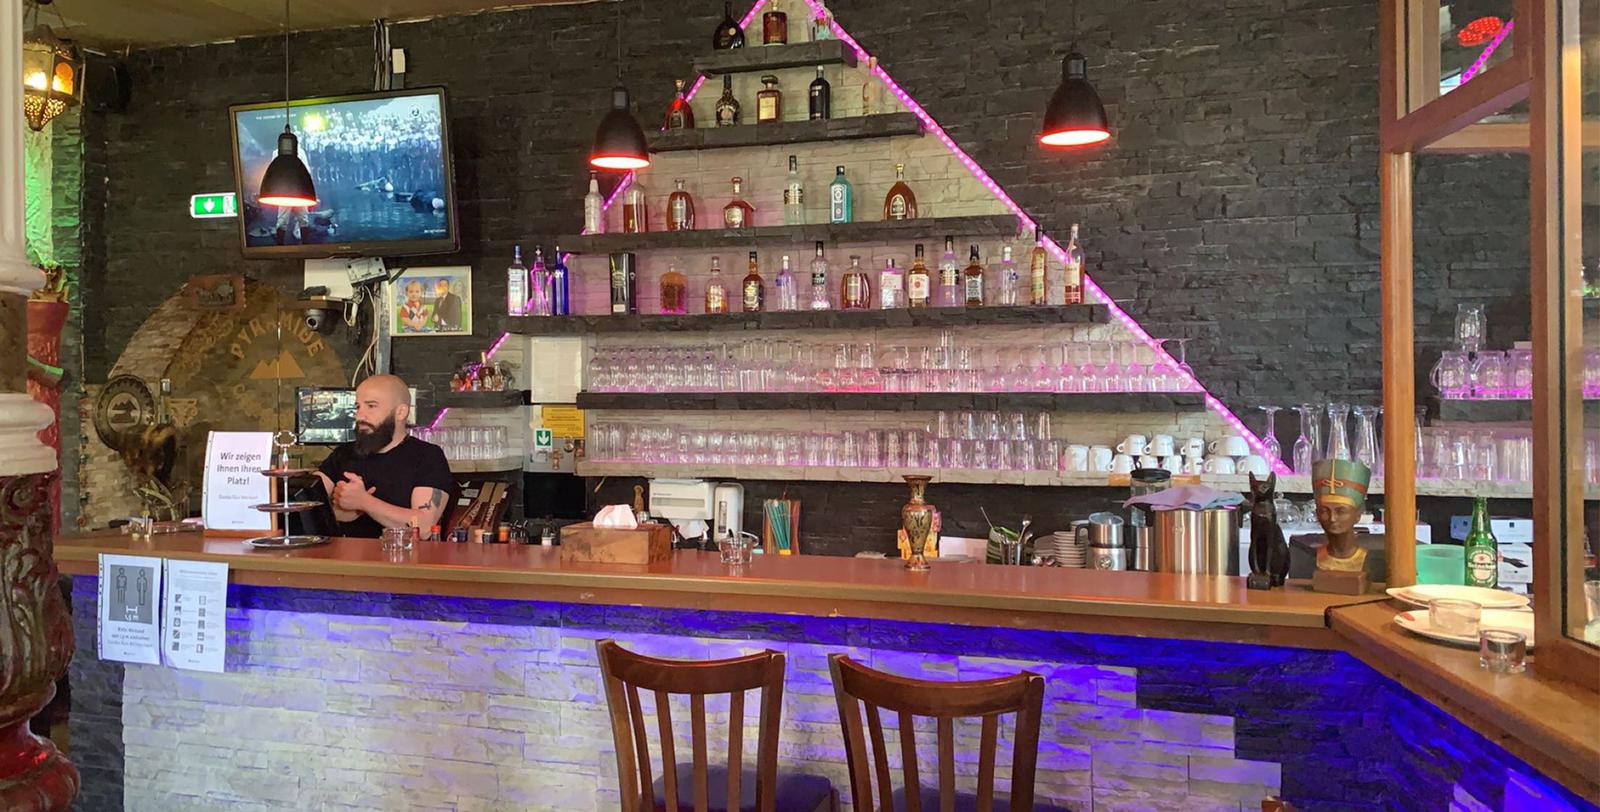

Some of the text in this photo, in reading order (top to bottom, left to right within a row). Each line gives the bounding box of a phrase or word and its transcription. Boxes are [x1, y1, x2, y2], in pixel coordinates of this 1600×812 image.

[230, 312, 325, 359] PYRAMIDE
[220, 452, 262, 463] Wir zeigen
[217, 464, 262, 473] Ihnen Ihren
[227, 476, 250, 485] Platz!
